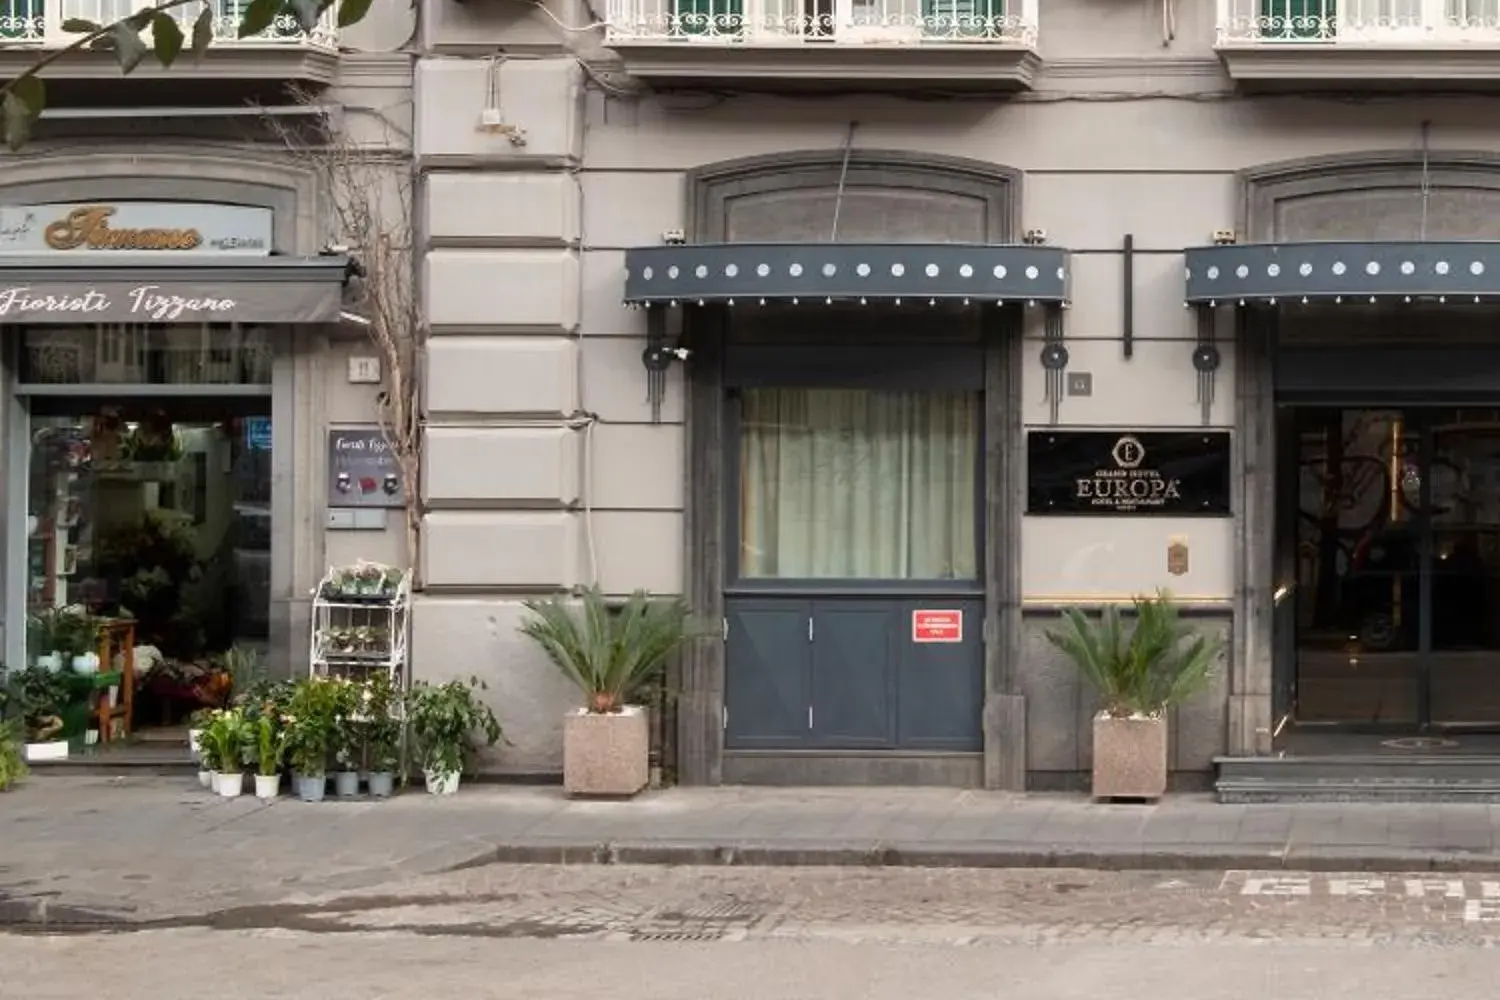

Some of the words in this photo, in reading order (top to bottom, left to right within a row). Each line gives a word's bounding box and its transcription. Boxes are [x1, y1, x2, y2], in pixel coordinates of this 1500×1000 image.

[0, 287, 111, 315] Fioristi
[128, 285, 236, 319] Tizzano
[1077, 479, 1178, 498] EUROPA
